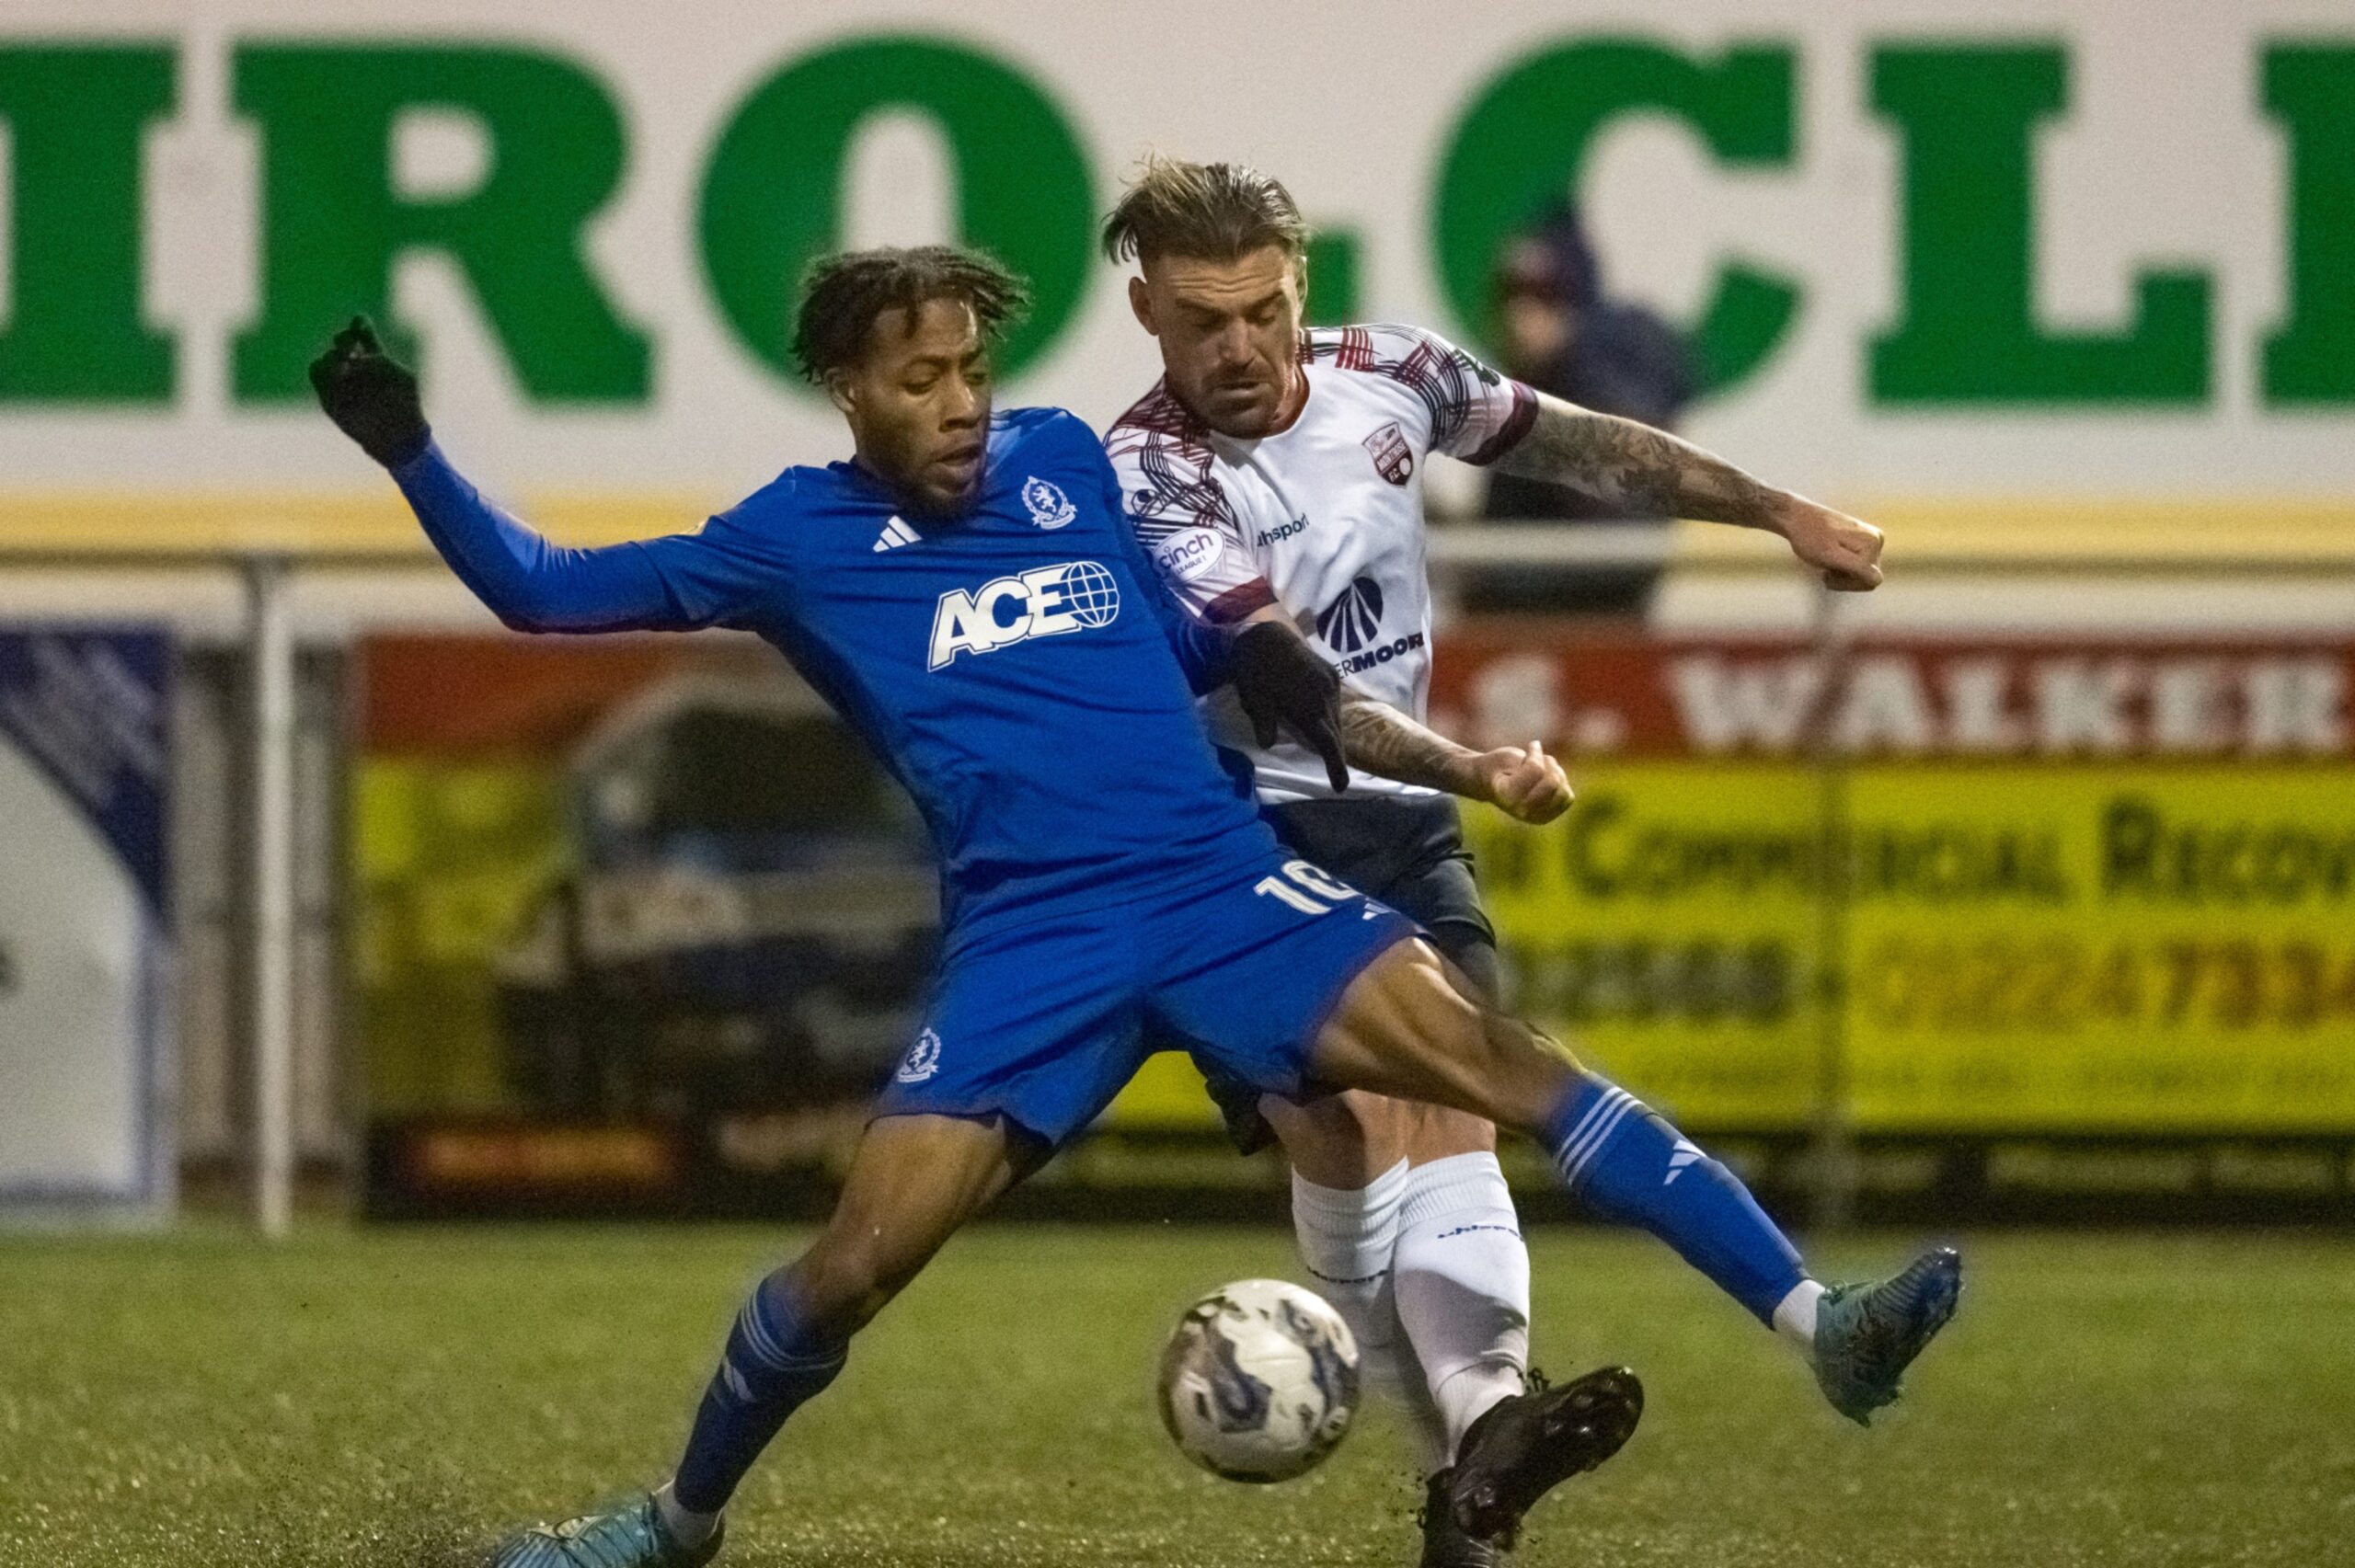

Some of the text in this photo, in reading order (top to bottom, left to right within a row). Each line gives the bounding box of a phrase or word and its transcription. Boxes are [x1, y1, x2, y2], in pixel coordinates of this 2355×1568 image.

[0, 33, 2355, 414] IROCL
[1159, 533, 1214, 570] cinch
[928, 563, 1082, 672] ACE
[1667, 657, 2344, 749] WALKER
